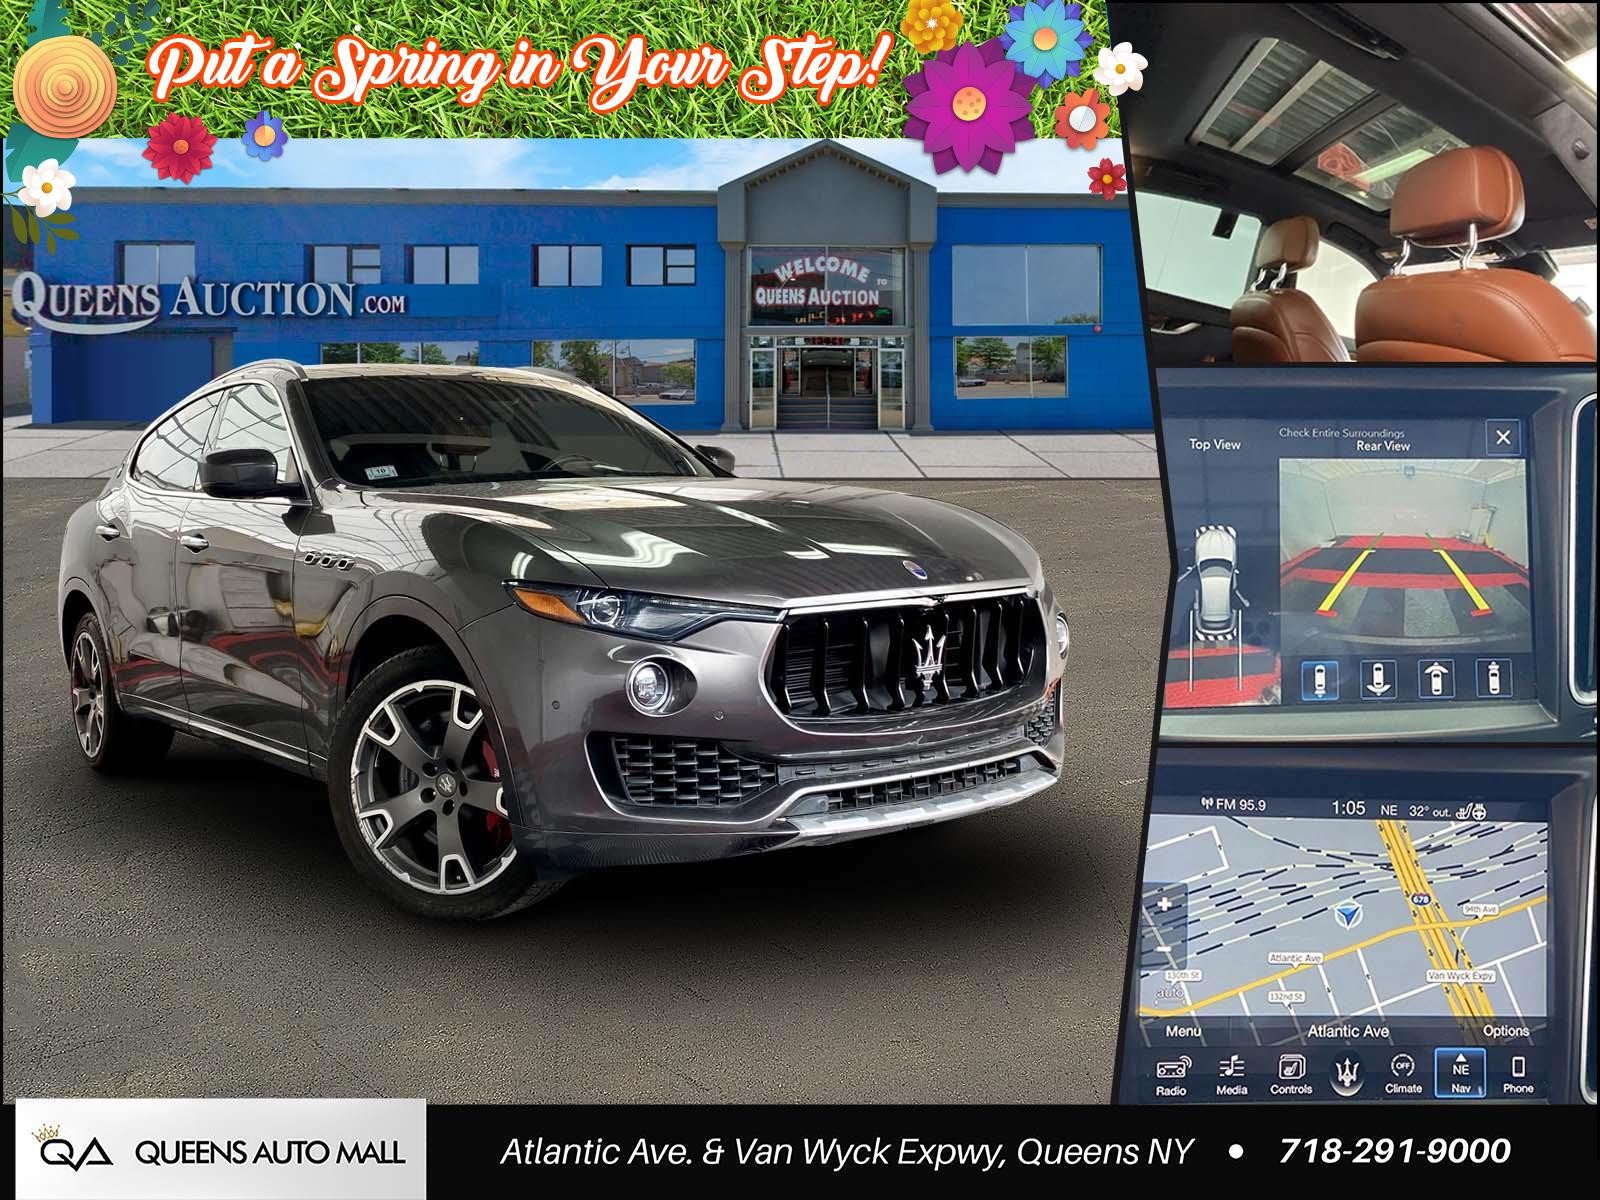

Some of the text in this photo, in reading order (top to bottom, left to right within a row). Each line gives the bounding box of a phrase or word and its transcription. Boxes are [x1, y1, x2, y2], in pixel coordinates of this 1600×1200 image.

[774, 255, 871, 283] WELCOME
[755, 287, 880, 306] QUEENS AUCTION
[11, 271, 160, 335] QUEENS
[169, 275, 356, 318] AUCTION
[1279, 427, 1405, 440] Check Entire Surroundings
[1189, 438, 1242, 453] Top View
[1356, 440, 1411, 452] Rear View
[1216, 799, 1267, 811] FM 95.9
[1332, 800, 1366, 816] 1:05
[1381, 804, 1398, 816] NE
[1432, 808, 1452, 818] out.
[1412, 896, 1430, 905] 678
[1464, 904, 1498, 914] 94th Ave
[1270, 952, 1321, 963] Atlantic Ave
[1167, 971, 1200, 980] 130th St
[1428, 970, 1494, 982] Van Wyck Expy
[1270, 993, 1303, 1002] 132nd St
[1166, 1025, 1202, 1038] Menu
[1307, 1024, 1389, 1038] Atlantic Ave
[1483, 1024, 1530, 1039] Options
[1395, 1061, 1411, 1070] OFF
[1452, 1064, 1470, 1076] NE
[1156, 1085, 1187, 1097] Radio
[1216, 1085, 1248, 1096] Media
[1270, 1084, 1313, 1095] Controls
[1385, 1083, 1423, 1094] Climate
[1451, 1083, 1472, 1093] Nav
[1503, 1083, 1535, 1094] Phone
